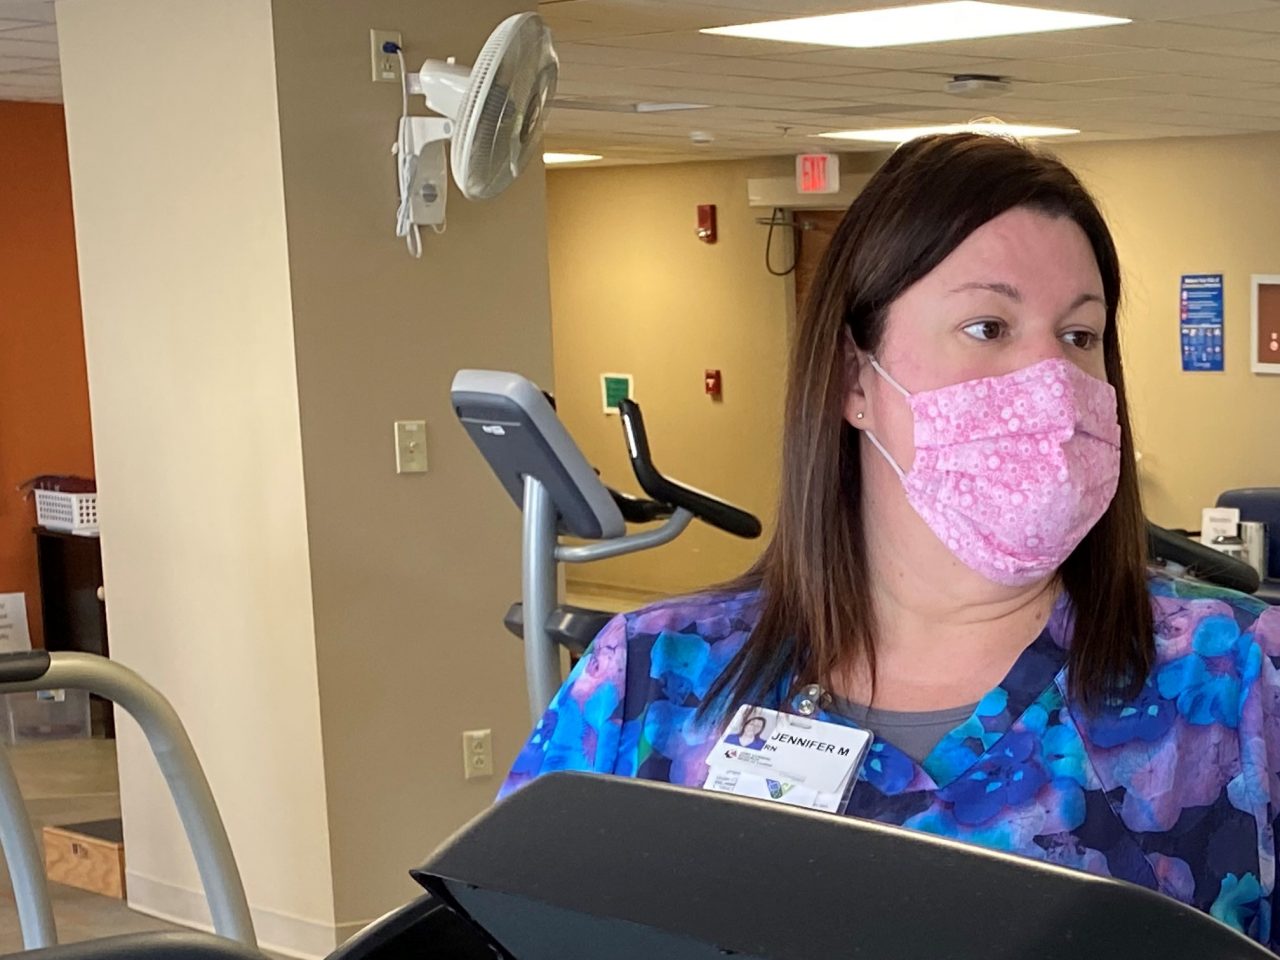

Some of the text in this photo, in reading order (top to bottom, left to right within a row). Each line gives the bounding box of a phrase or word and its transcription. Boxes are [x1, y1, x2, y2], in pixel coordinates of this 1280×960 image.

[763, 744, 778, 752] RN
[771, 732, 850, 757] JENNIFER M
